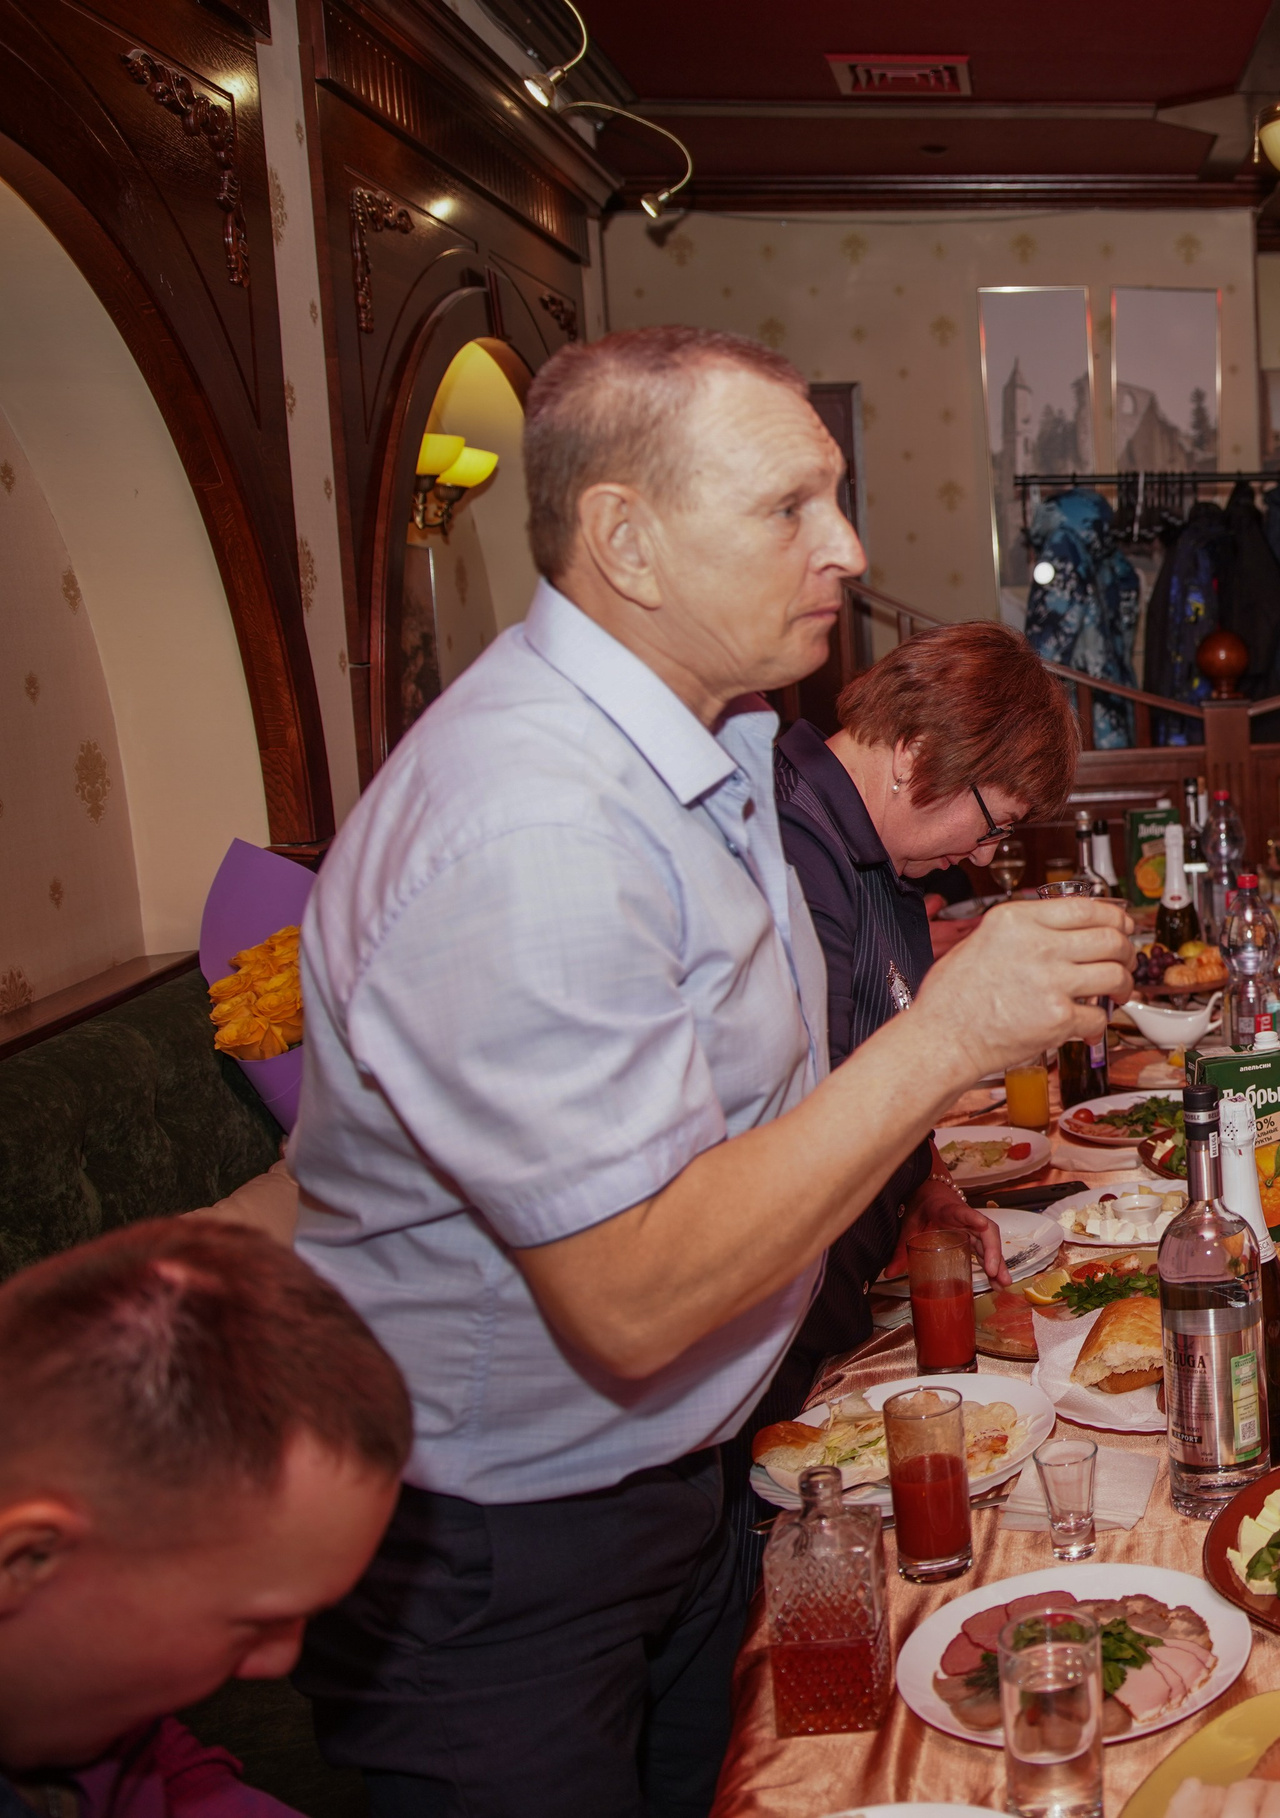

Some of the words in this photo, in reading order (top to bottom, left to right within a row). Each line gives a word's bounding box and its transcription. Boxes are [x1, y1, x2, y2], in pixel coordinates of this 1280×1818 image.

[1239, 1063, 1271, 1072] апельсин
[1255, 1116, 1275, 1131] 0%
[1254, 1136, 1273, 1146] РУКТЫ
[1173, 1430, 1199, 1443] EXPORT
